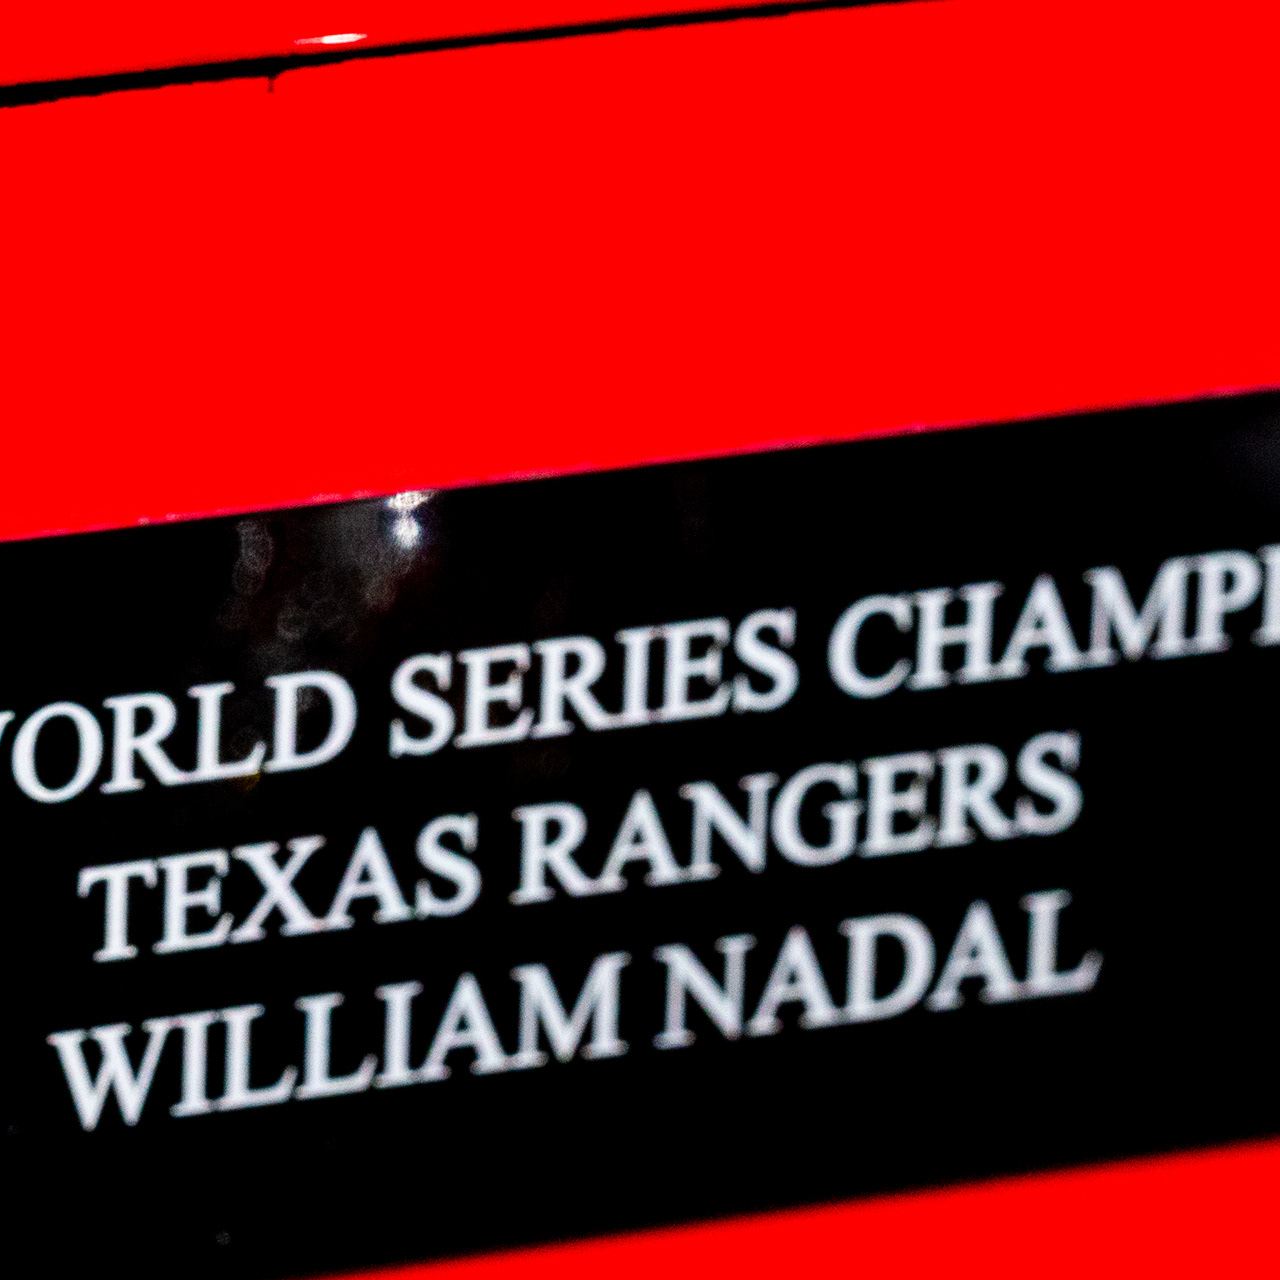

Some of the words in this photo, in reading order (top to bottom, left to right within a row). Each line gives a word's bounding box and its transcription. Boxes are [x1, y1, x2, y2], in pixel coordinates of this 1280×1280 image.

[388, 608, 798, 756] SERIES
[76, 814, 482, 962] TEXAS
[511, 731, 1082, 905] RANGERS
[47, 951, 629, 1130] WILLIAM
[655, 889, 1100, 1049] NADAL
